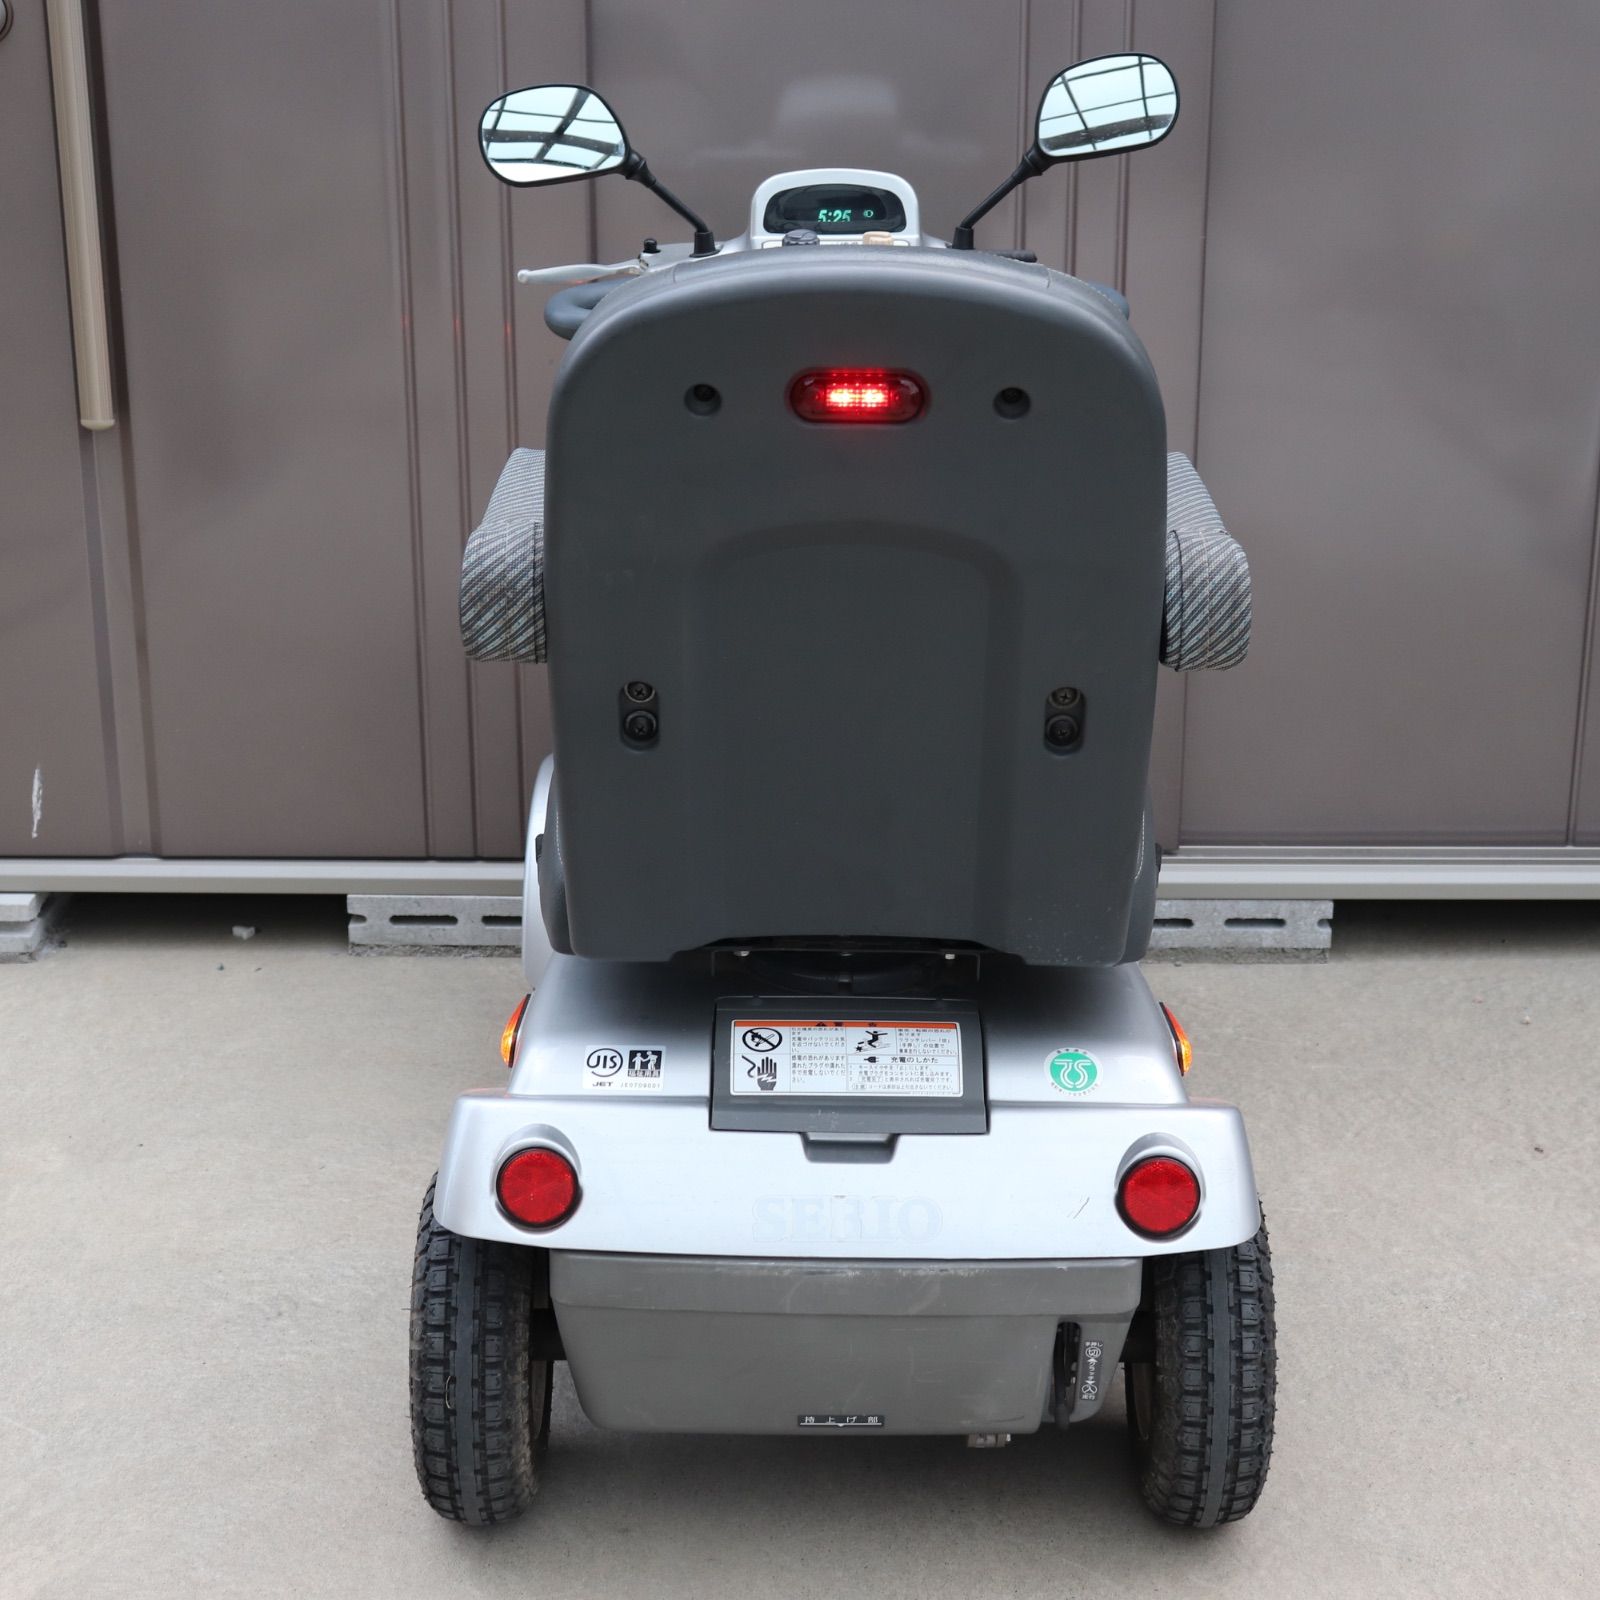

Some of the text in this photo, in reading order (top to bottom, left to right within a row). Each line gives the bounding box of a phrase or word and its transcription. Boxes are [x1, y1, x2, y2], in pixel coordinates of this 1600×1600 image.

[817, 209, 852, 223] 5:25
[588, 1055, 617, 1069] JIS
[804, 1415, 879, 1424] 持上げ部
